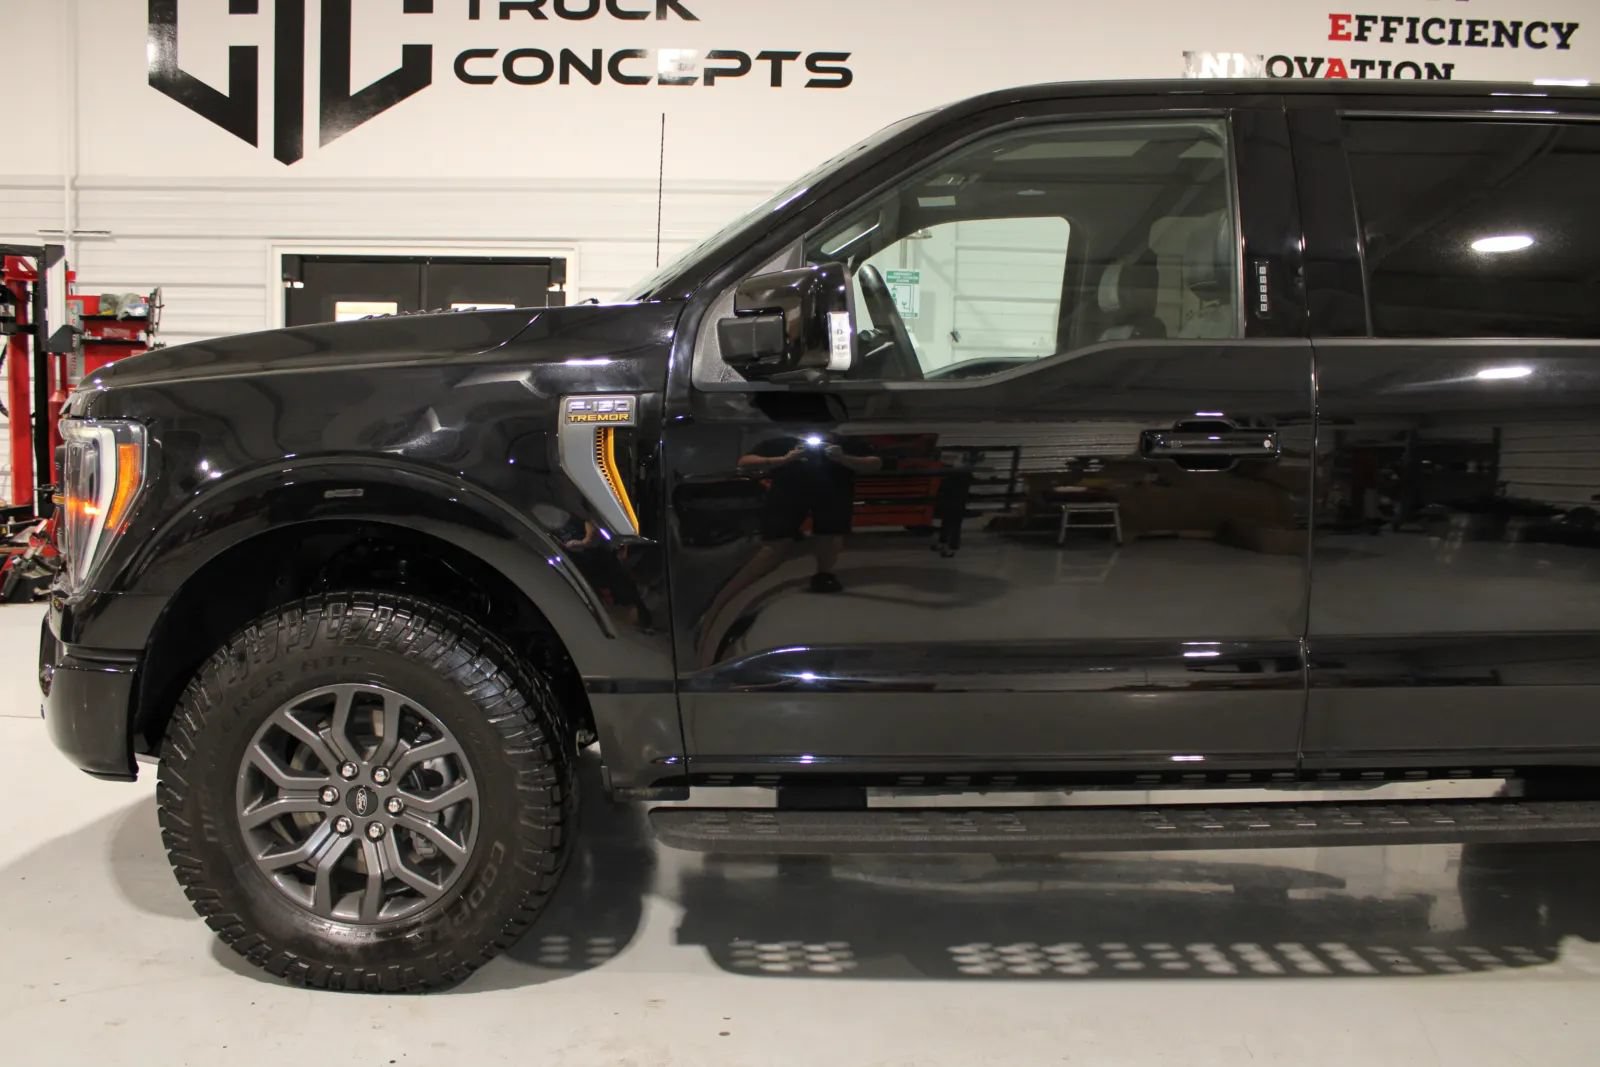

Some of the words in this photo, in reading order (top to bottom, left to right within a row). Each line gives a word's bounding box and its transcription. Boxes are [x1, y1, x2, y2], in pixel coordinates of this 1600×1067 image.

[1328, 13, 1579, 50] EFFICIENCY
[453, 48, 853, 89] CONCEPTS
[1182, 50, 1455, 80] INNOVATION
[568, 413, 630, 422] TREMOR
